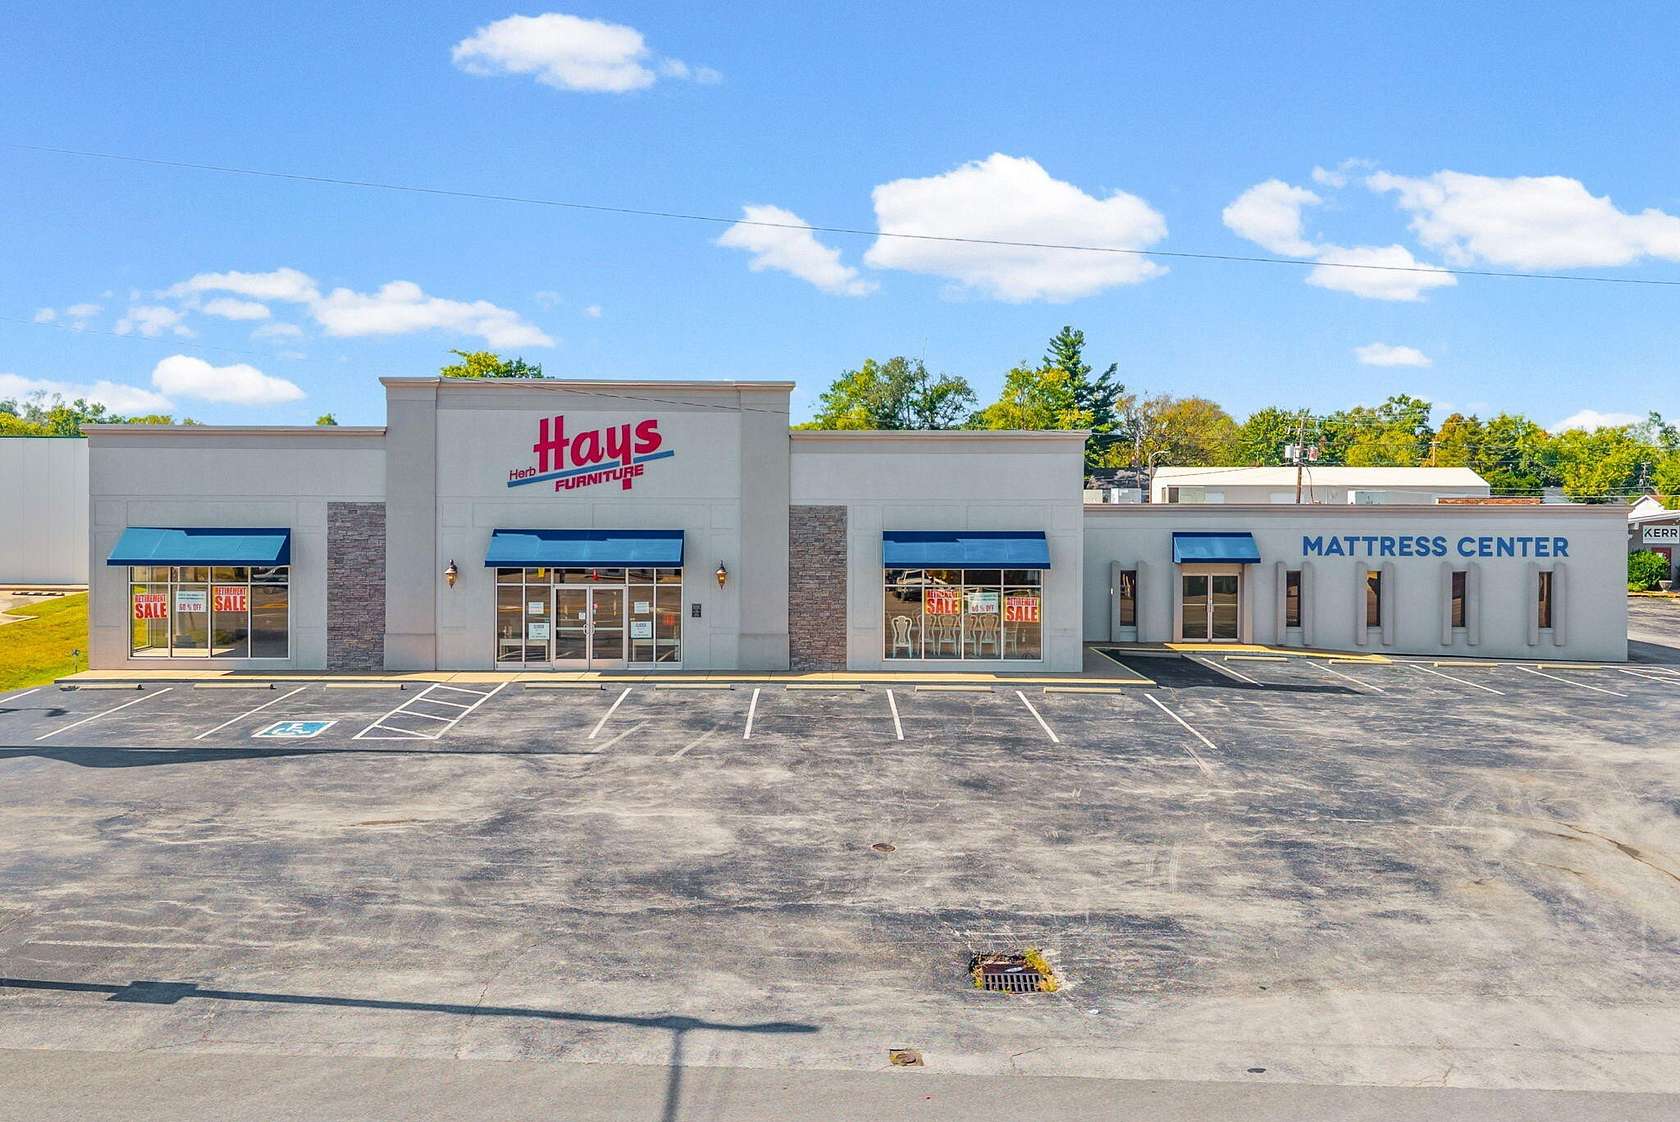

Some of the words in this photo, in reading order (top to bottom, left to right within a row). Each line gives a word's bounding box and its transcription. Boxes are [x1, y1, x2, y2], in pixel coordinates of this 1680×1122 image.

[509, 467, 536, 480] Herb
[533, 415, 662, 490] Hays
[555, 464, 644, 492] FURNITURE
[1644, 528, 1678, 538] KERR
[1303, 535, 1448, 557] MATTRESS
[1457, 536, 1569, 557] CENTER
[135, 603, 167, 618] SALE
[215, 596, 246, 611] SALE
[927, 599, 958, 614] SALE
[1006, 606, 1038, 621] SALE
